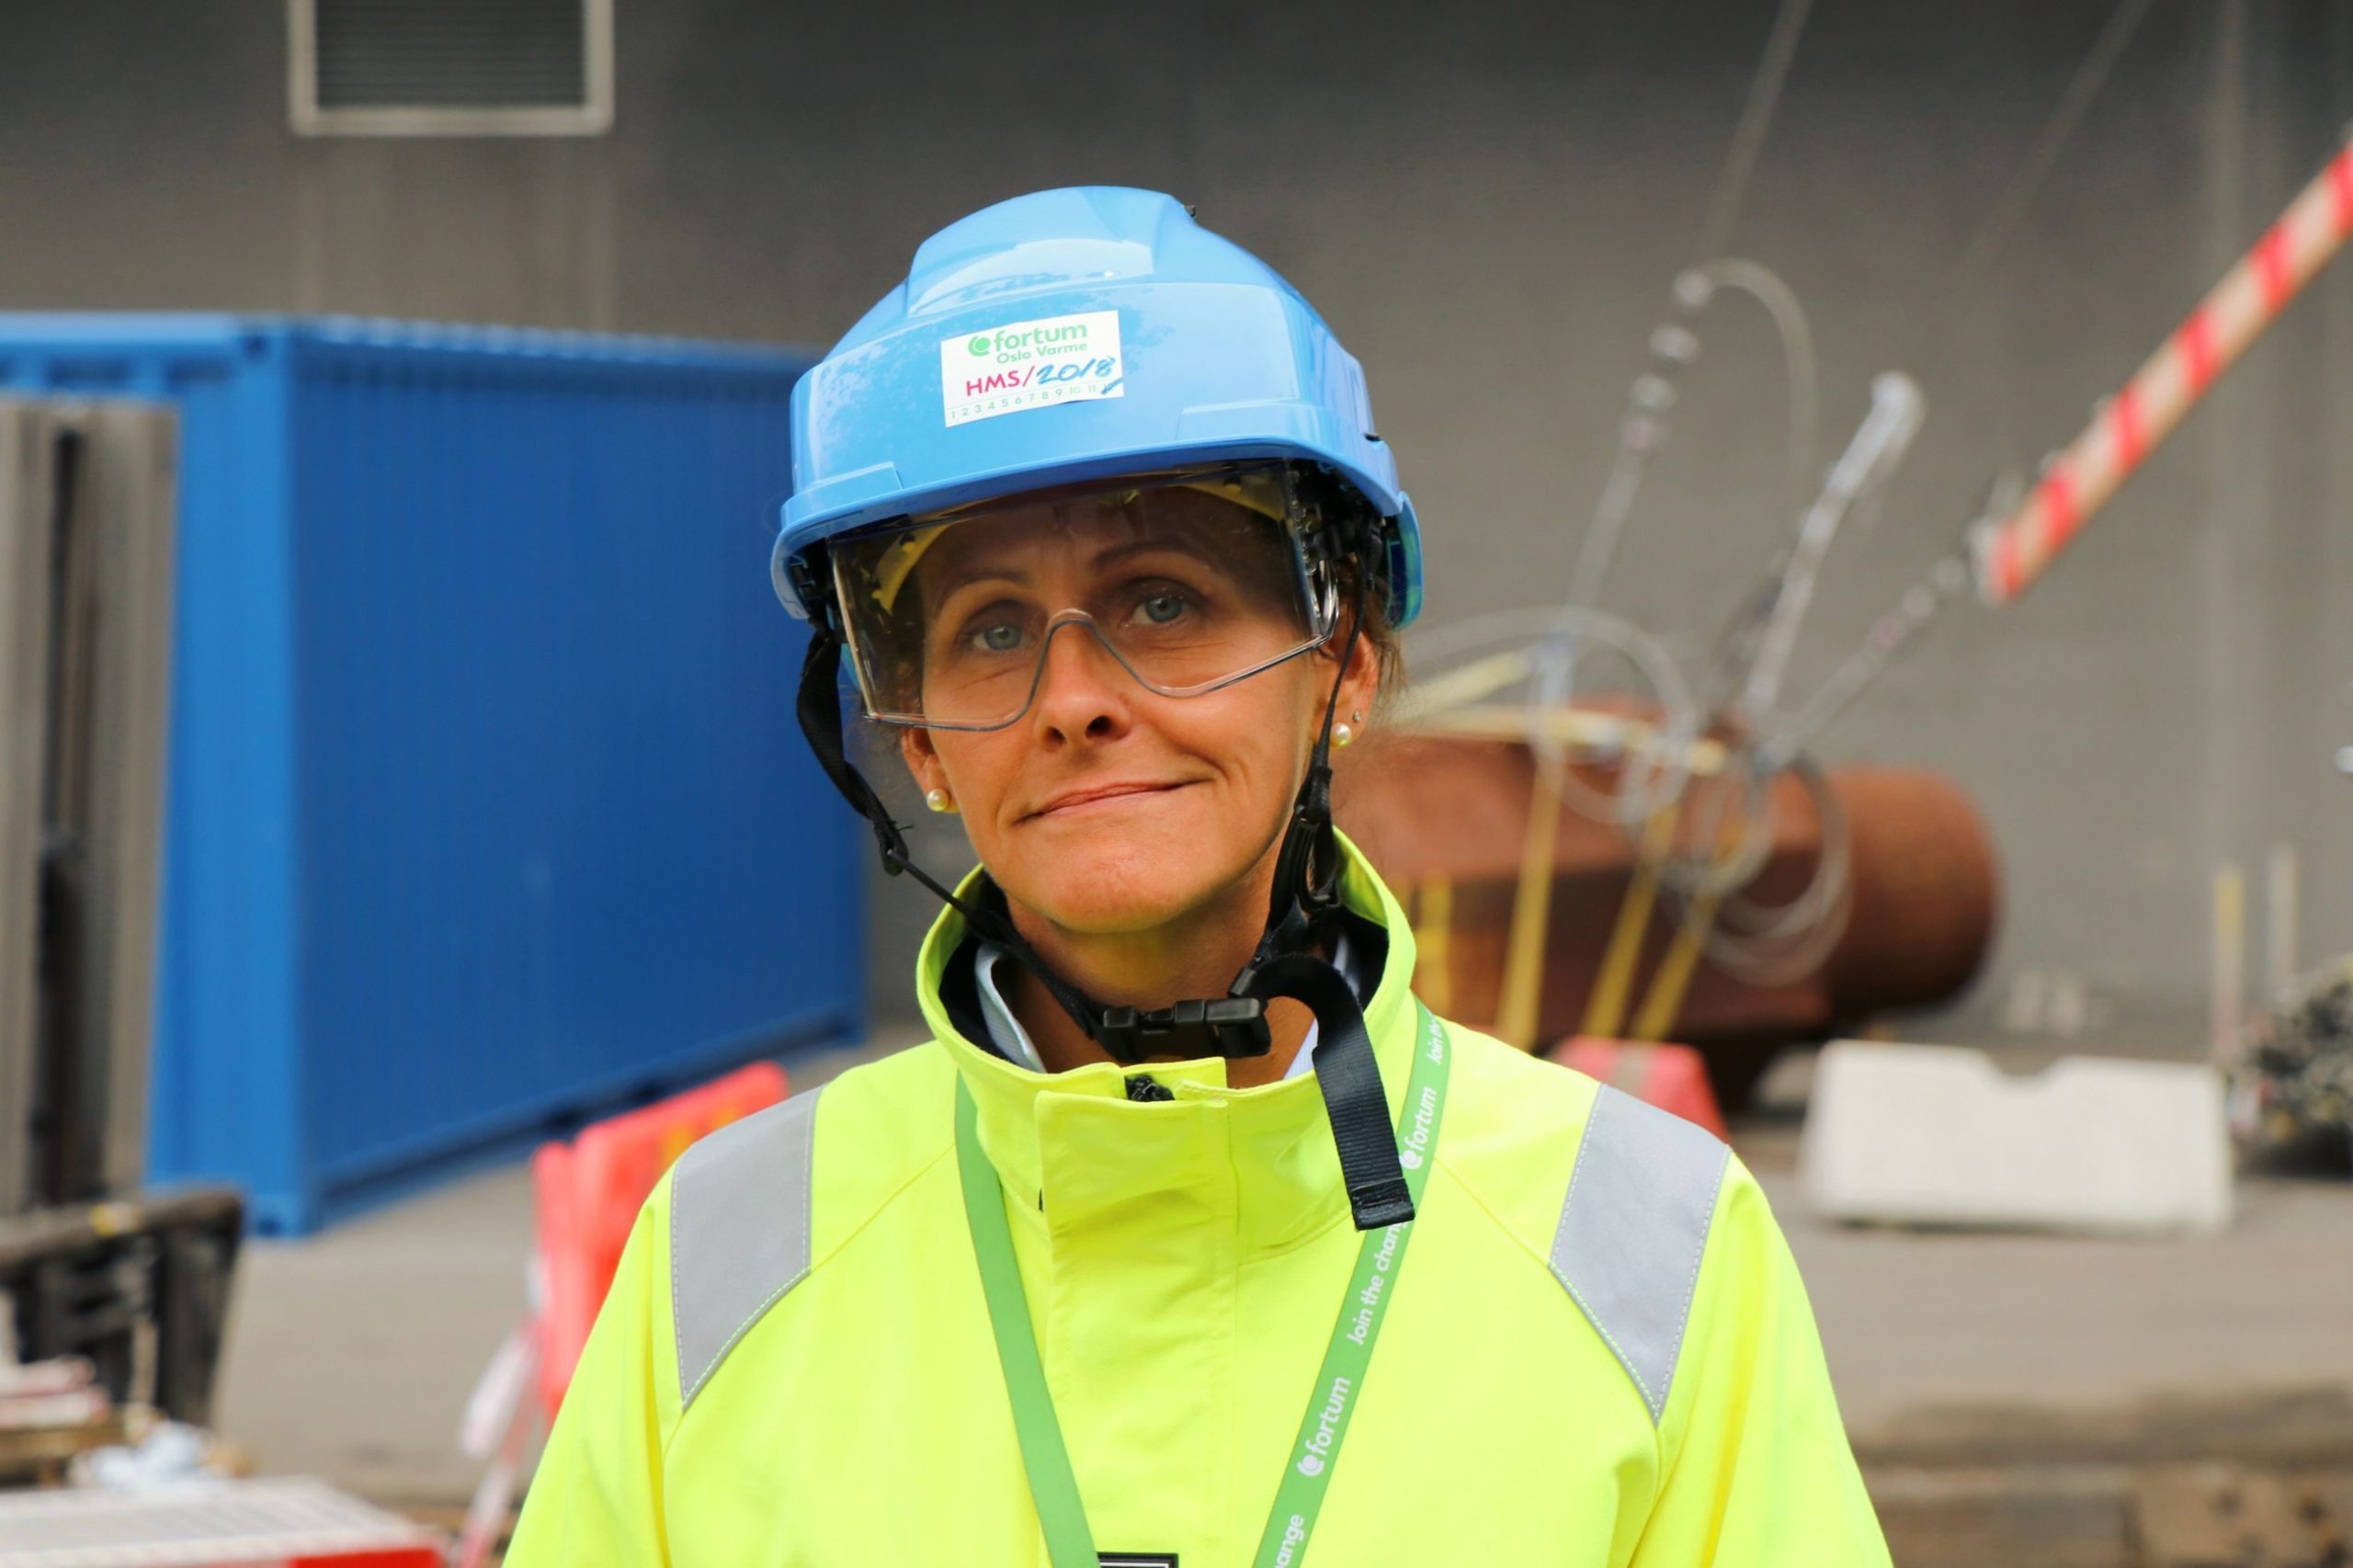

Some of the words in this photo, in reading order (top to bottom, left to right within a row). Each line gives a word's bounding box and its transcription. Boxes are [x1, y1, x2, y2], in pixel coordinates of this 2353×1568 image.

[994, 324, 1088, 352] fortum
[996, 348, 1032, 365] Oslo
[1035, 342, 1088, 358] Varme
[975, 404, 983, 414] 3
[987, 401, 996, 410] 4
[1001, 398, 1009, 407] 5
[1015, 395, 1023, 404] 6
[1029, 392, 1036, 402] 7
[1041, 391, 1050, 400] 8
[1055, 388, 1063, 397] 9
[1069, 386, 1082, 395] 10
[1087, 384, 1097, 393] 11
[1404, 1086, 1438, 1153] fortum
[1346, 1308, 1374, 1346] Join
[1360, 1275, 1385, 1306] the
[1304, 1376, 1352, 1456] fortum
[1274, 1514, 1305, 1568] ange
